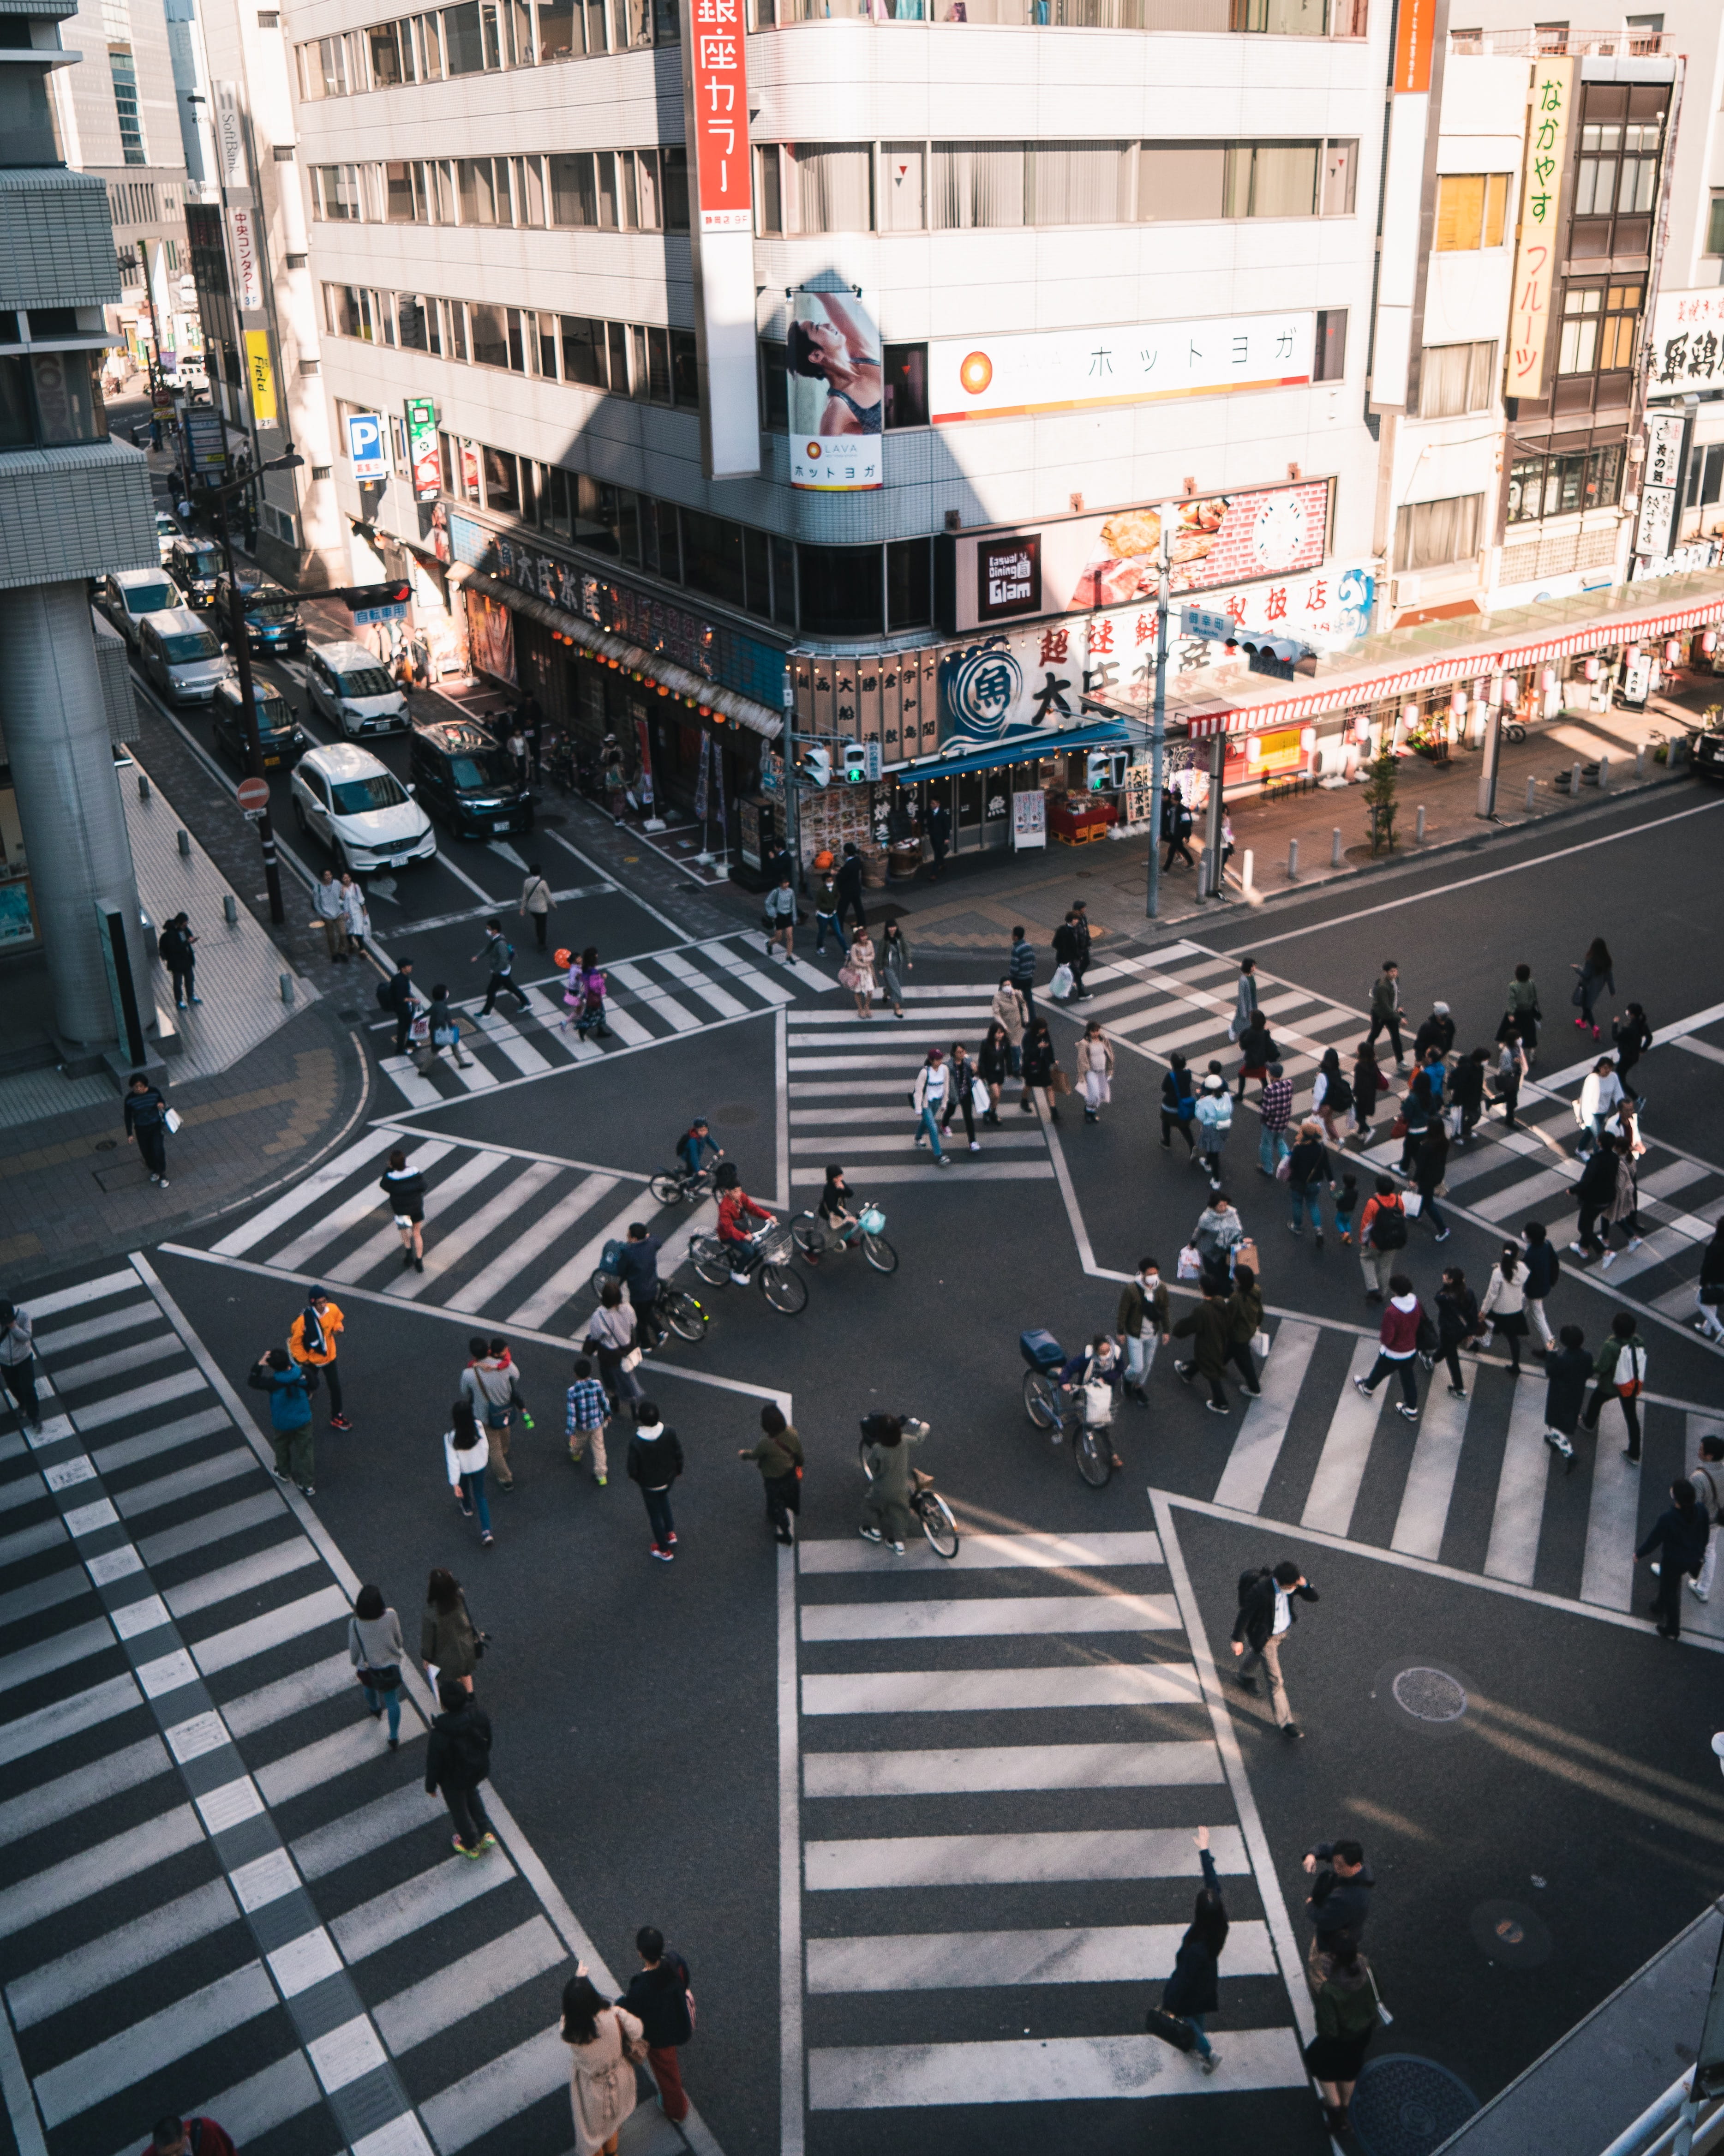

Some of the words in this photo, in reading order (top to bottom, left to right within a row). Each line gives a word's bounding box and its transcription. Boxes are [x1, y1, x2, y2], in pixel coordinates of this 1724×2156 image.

[698, 0, 737, 192] 銀座カラー
[221, 114, 239, 174] SoftBank
[1531, 79, 1563, 225] なかやす
[735, 216, 747, 224] 9F
[234, 213, 254, 294] 中央コンタクト
[245, 296, 257, 306] 3F
[1515, 246, 1547, 378] フルーツ
[254, 356, 267, 392] Field
[1089, 327, 1297, 377] ホットヨガ
[1660, 330, 1724, 384] 軍鶏
[351, 422, 378, 455] P
[420, 490, 437, 500] 2F
[795, 464, 875, 478] ホットヨガ
[989, 553, 1017, 567] Casual
[989, 565, 1017, 580] Dining
[989, 579, 1031, 605] Glam
[1039, 580, 1329, 667] 超速鮮取扱店
[1189, 612, 1224, 631] 御幸町
[885, 673, 898, 744] 倉敷
[903, 670, 917, 739] 宇和島
[922, 666, 935, 737] 下関
